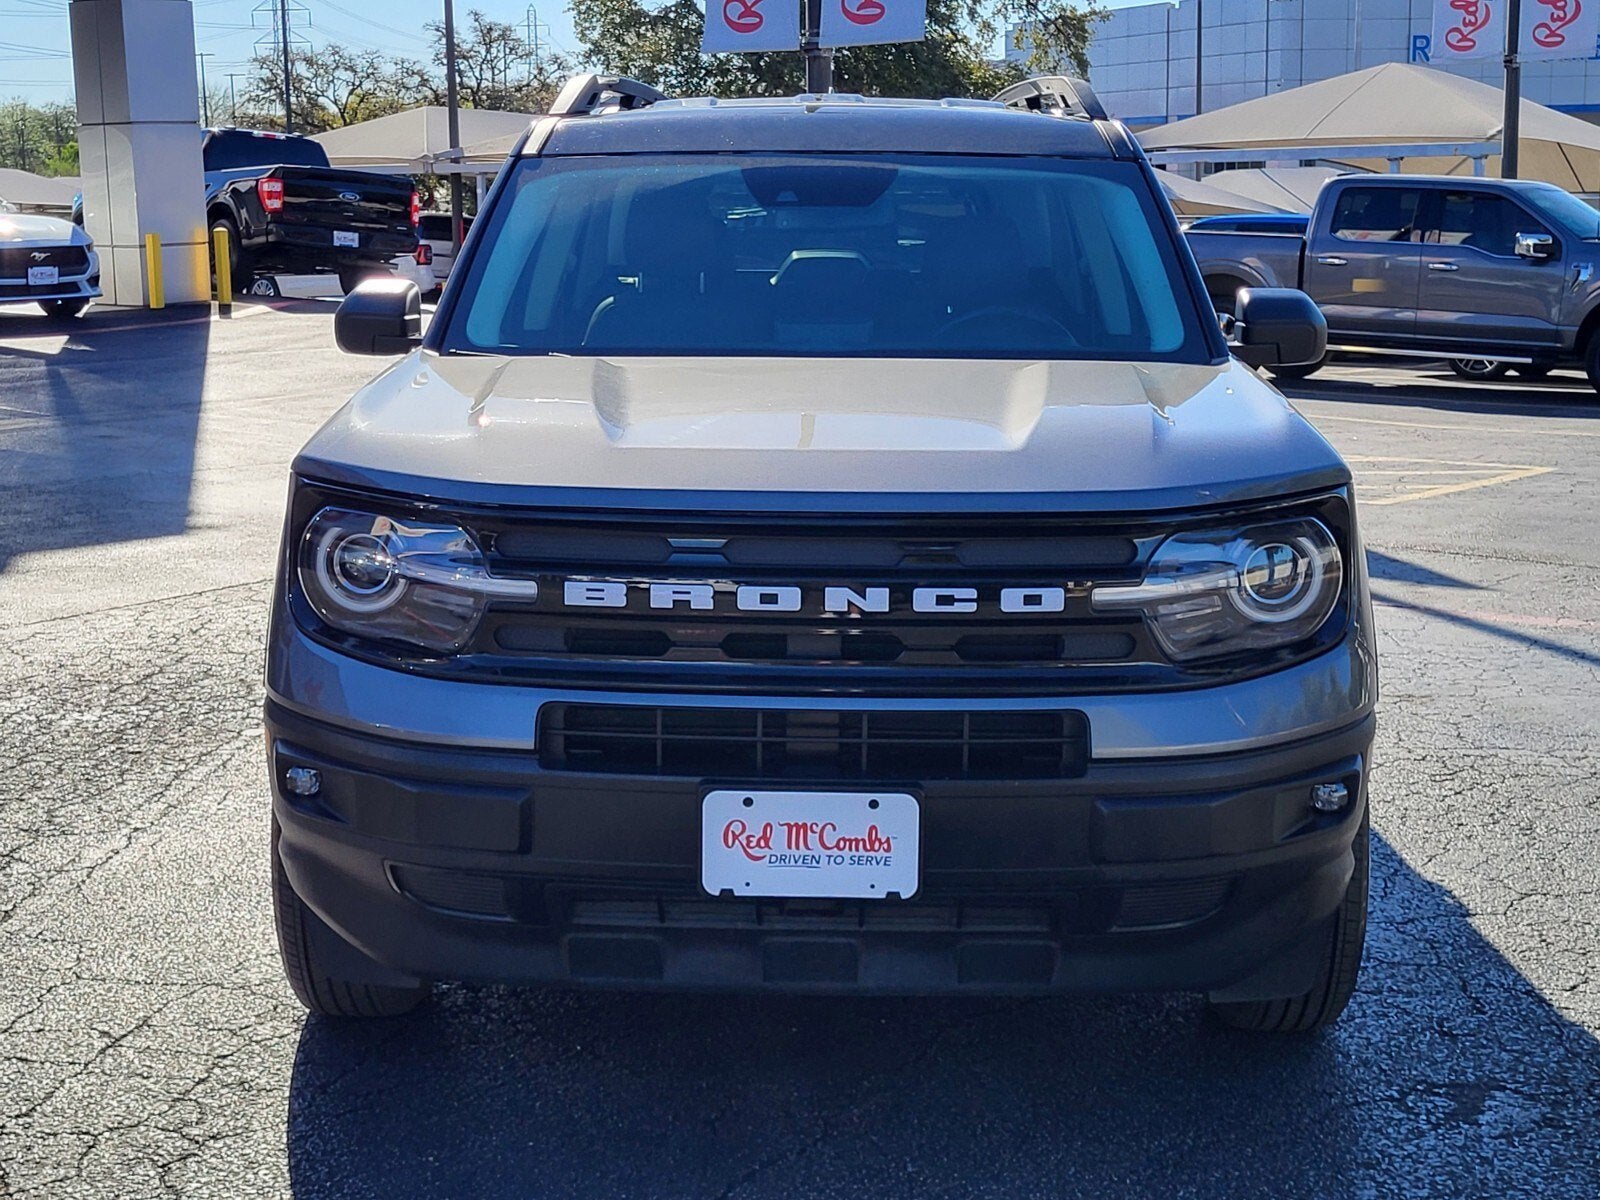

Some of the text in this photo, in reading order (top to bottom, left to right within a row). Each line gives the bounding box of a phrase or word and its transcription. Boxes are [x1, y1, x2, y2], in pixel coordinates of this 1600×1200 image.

[564, 581, 1066, 613] BRONCO
[723, 819, 892, 861] Red McCombs
[768, 854, 892, 867] DRIVEN TO SERVE
